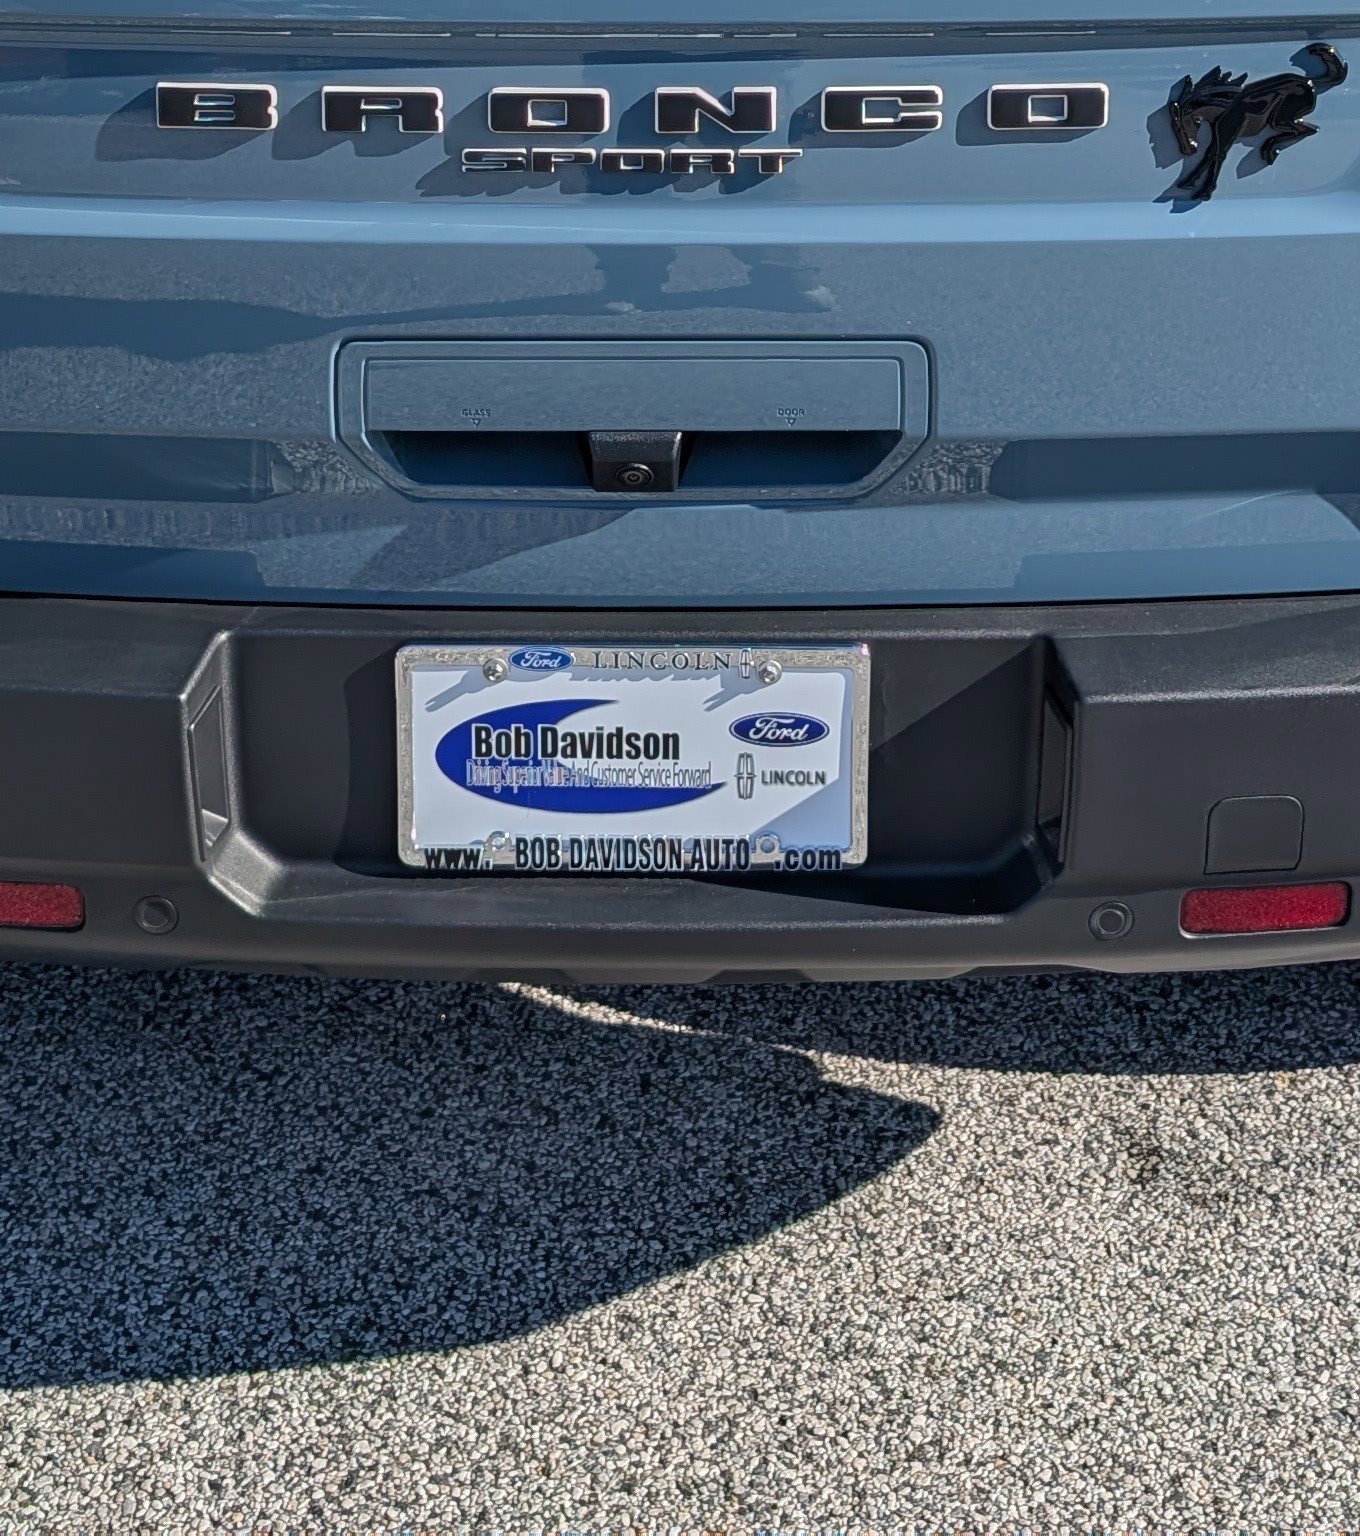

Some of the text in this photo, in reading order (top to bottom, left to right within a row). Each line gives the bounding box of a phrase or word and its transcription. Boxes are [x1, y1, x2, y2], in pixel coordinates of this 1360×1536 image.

[155, 81, 1109, 135] BRONCO
[460, 148, 804, 175] SPORT
[461, 407, 491, 418] GLASS
[777, 407, 805, 418] DOOR
[519, 649, 733, 671] Ford LINCOLN
[473, 723, 681, 760] Bob Davidson
[748, 716, 811, 743] Ford
[592, 761, 636, 788] Customer
[637, 761, 671, 788] Service
[673, 761, 712, 788] Forward
[760, 769, 826, 786] LINCOLN
[515, 835, 563, 871] BOB
[570, 836, 684, 871] DAVIDSON
[689, 836, 750, 871] AUTO
